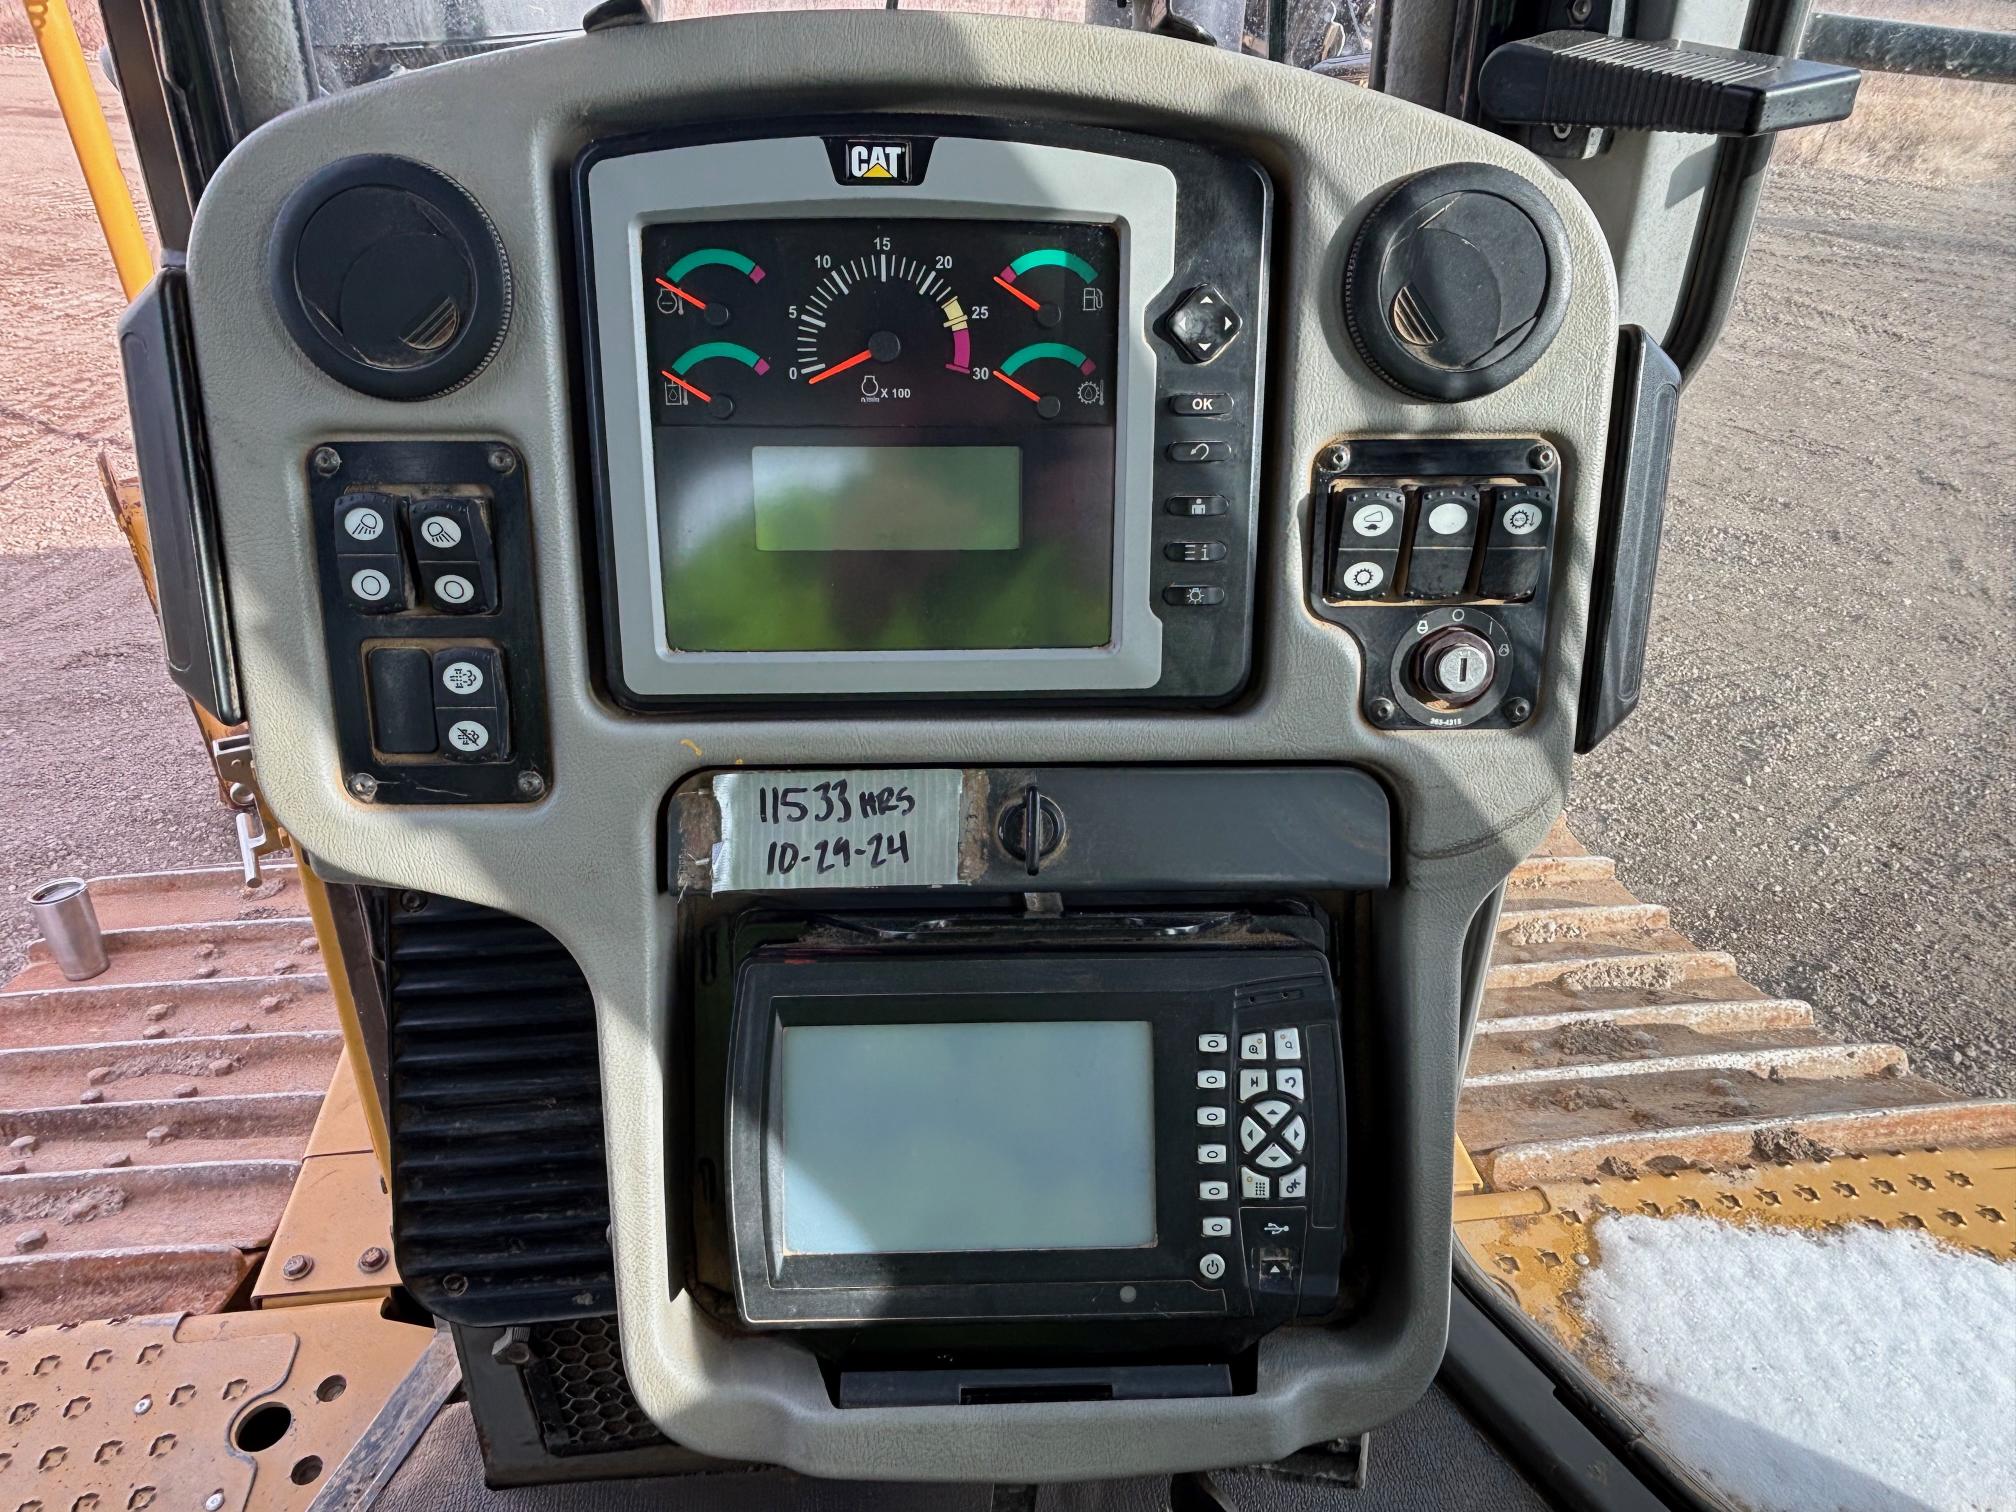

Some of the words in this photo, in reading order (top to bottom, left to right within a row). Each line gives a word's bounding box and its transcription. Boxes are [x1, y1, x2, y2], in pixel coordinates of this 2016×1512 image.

[851, 145, 902, 178] CAT
[873, 237, 891, 251] 15
[814, 254, 832, 269] 10
[935, 255, 953, 269] 20
[788, 305, 798, 319] 5
[971, 305, 989, 319] 25
[788, 366, 798, 380] 0
[972, 367, 989, 381] 30
[892, 387, 911, 399] 100
[1191, 397, 1214, 411] OK
[759, 778, 852, 825] 11533
[859, 786, 916, 819] HRS
[766, 830, 910, 876] 10-29-24
[1285, 1178, 1302, 1194] OK
